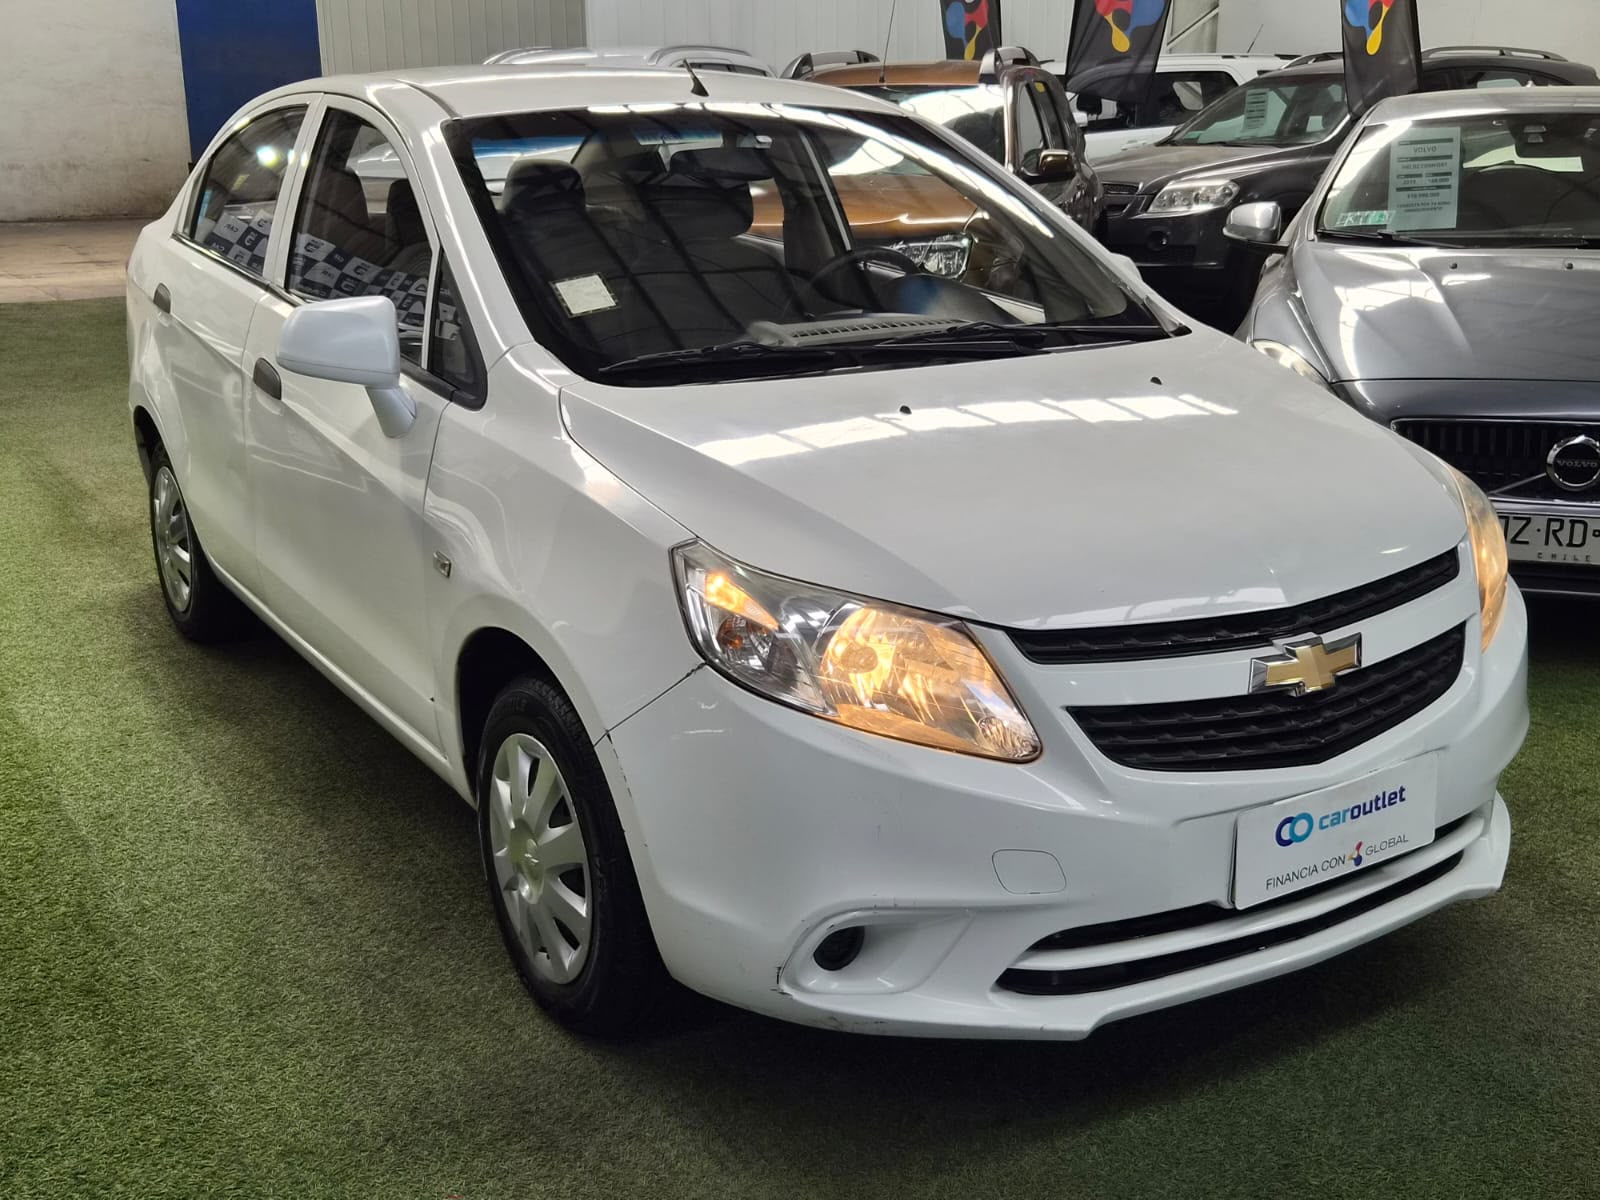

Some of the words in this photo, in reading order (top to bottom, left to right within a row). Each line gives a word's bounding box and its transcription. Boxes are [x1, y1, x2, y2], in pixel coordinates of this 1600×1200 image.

[1413, 145, 1437, 153] VOLVO
[1556, 459, 1598, 469] VOLVO
[1537, 552, 1591, 562] CHILE
[1318, 785, 1406, 831] caroutlet
[1265, 864, 1319, 891] FINANCIA
[1321, 854, 1346, 872] CON
[1365, 834, 1409, 856] GLOBAL
